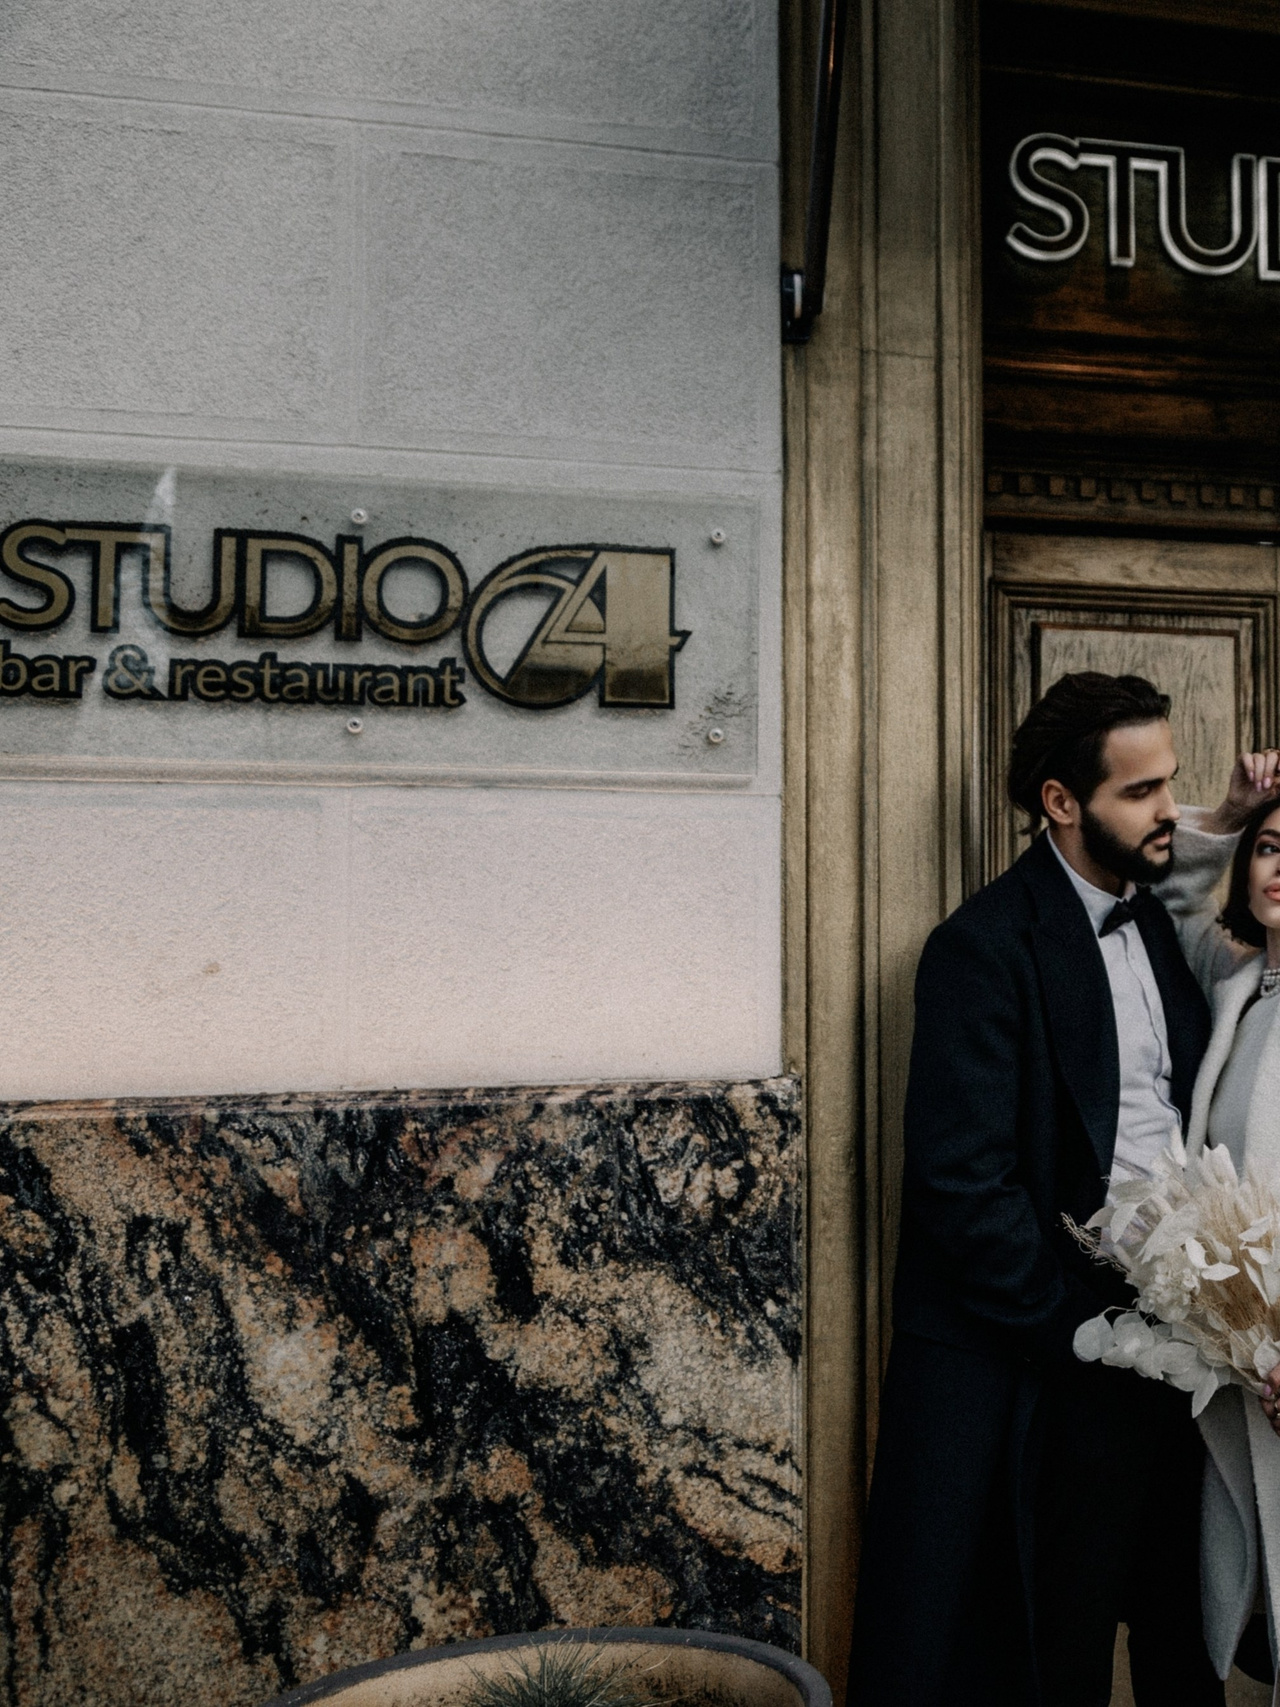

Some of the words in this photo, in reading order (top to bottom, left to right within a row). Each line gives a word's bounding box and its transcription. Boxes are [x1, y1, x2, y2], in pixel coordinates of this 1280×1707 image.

[0, 640, 96, 699] bar
[102, 644, 158, 700] &
[168, 652, 467, 708] restaurant
